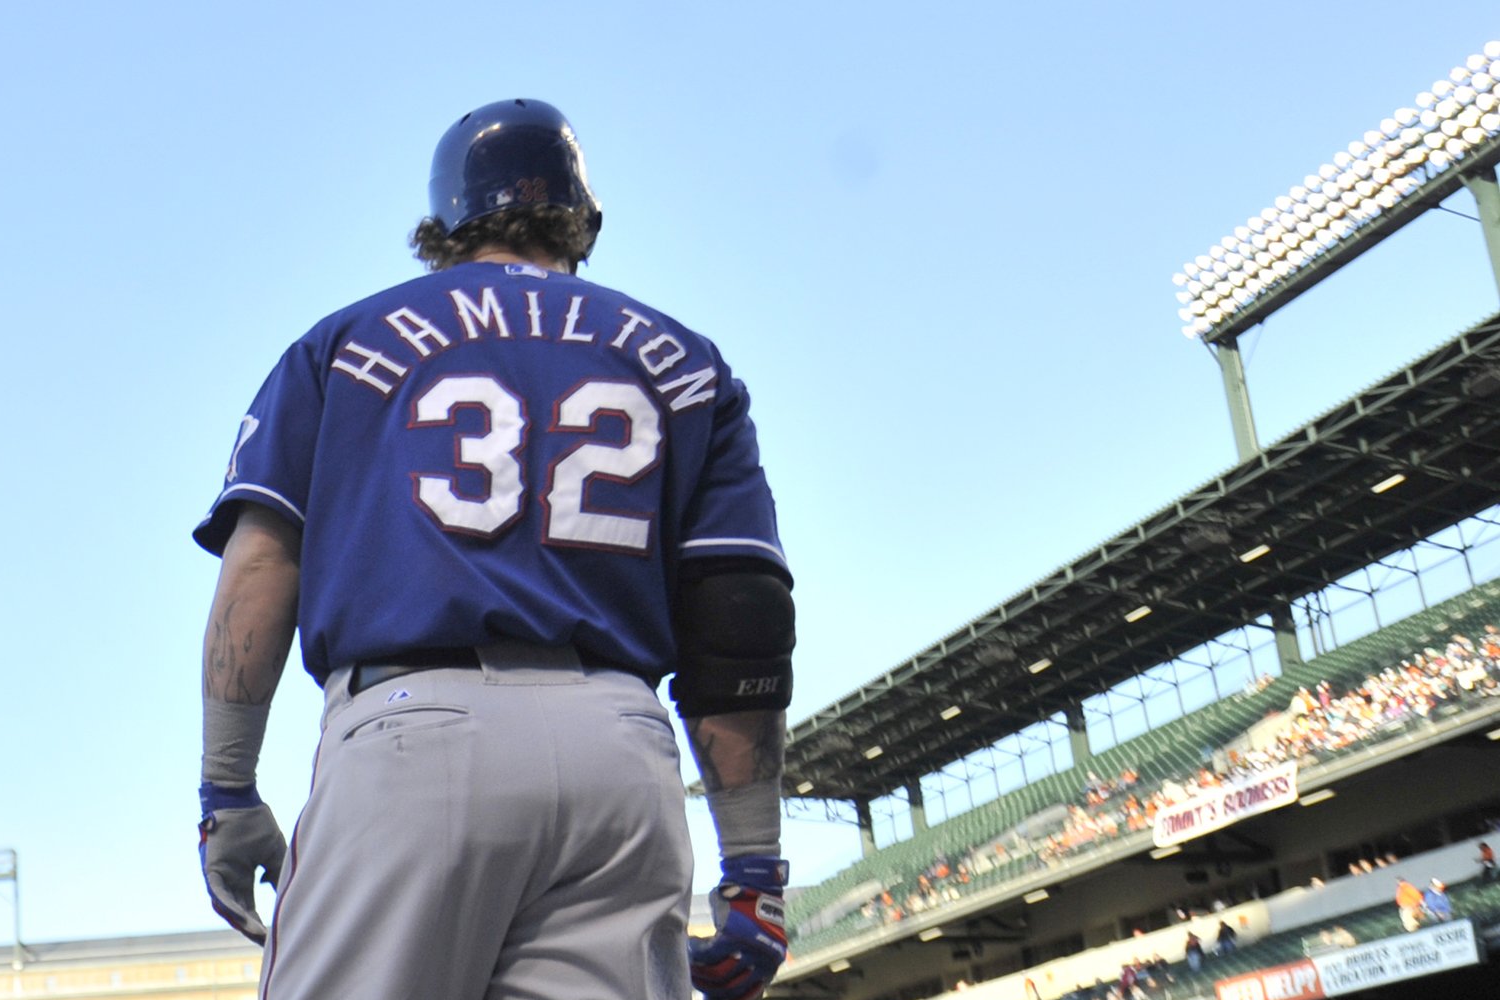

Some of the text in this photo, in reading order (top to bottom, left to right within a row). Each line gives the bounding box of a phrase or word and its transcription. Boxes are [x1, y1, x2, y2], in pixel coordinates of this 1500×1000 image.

[330, 285, 718, 414] HAMILTON
[407, 371, 666, 558] 32
[734, 676, 781, 696] EBI
